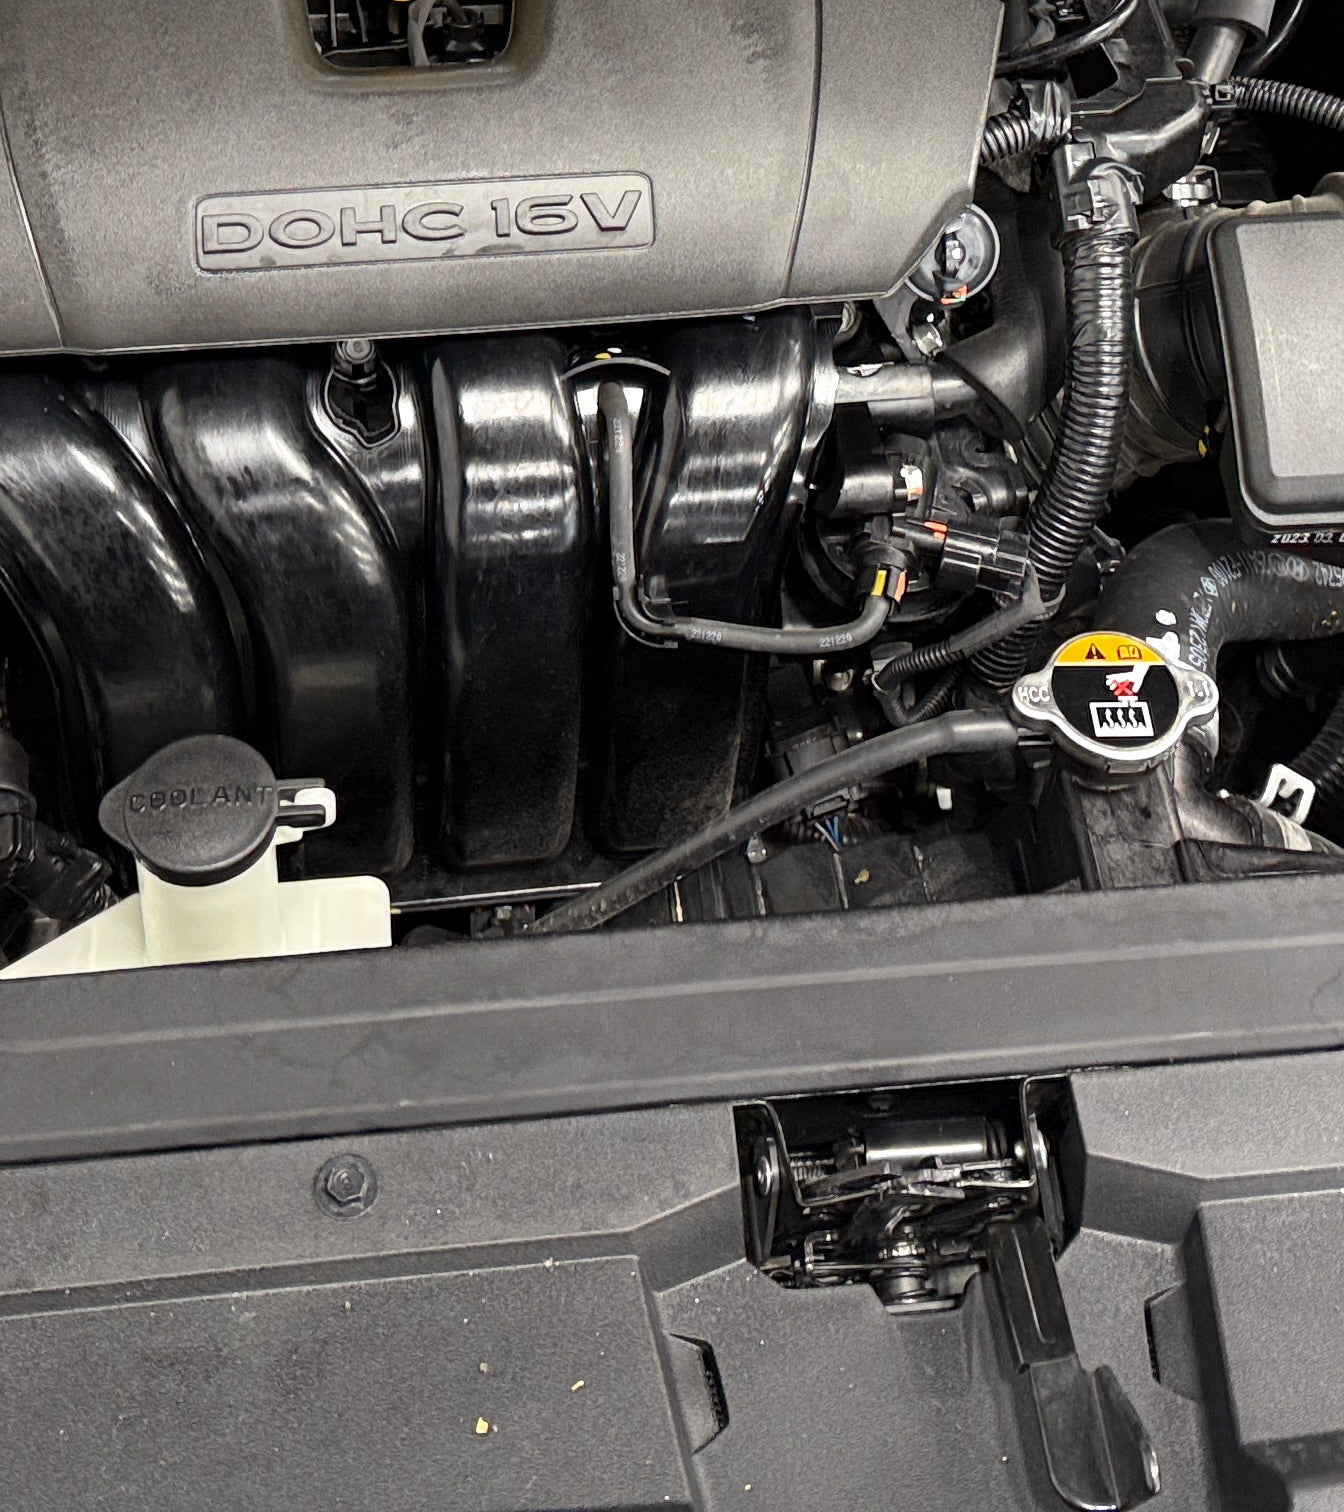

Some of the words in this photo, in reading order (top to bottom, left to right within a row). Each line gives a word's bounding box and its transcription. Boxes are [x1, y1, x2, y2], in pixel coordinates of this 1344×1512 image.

[201, 201, 467, 255] DOHC
[491, 189, 642, 238] 16V
[1269, 533, 1310, 544] 2023
[1313, 532, 1333, 544] 03
[1017, 686, 1050, 703] HCC
[1186, 680, 1211, 698] 1.1
[130, 785, 274, 814] COOLANT
